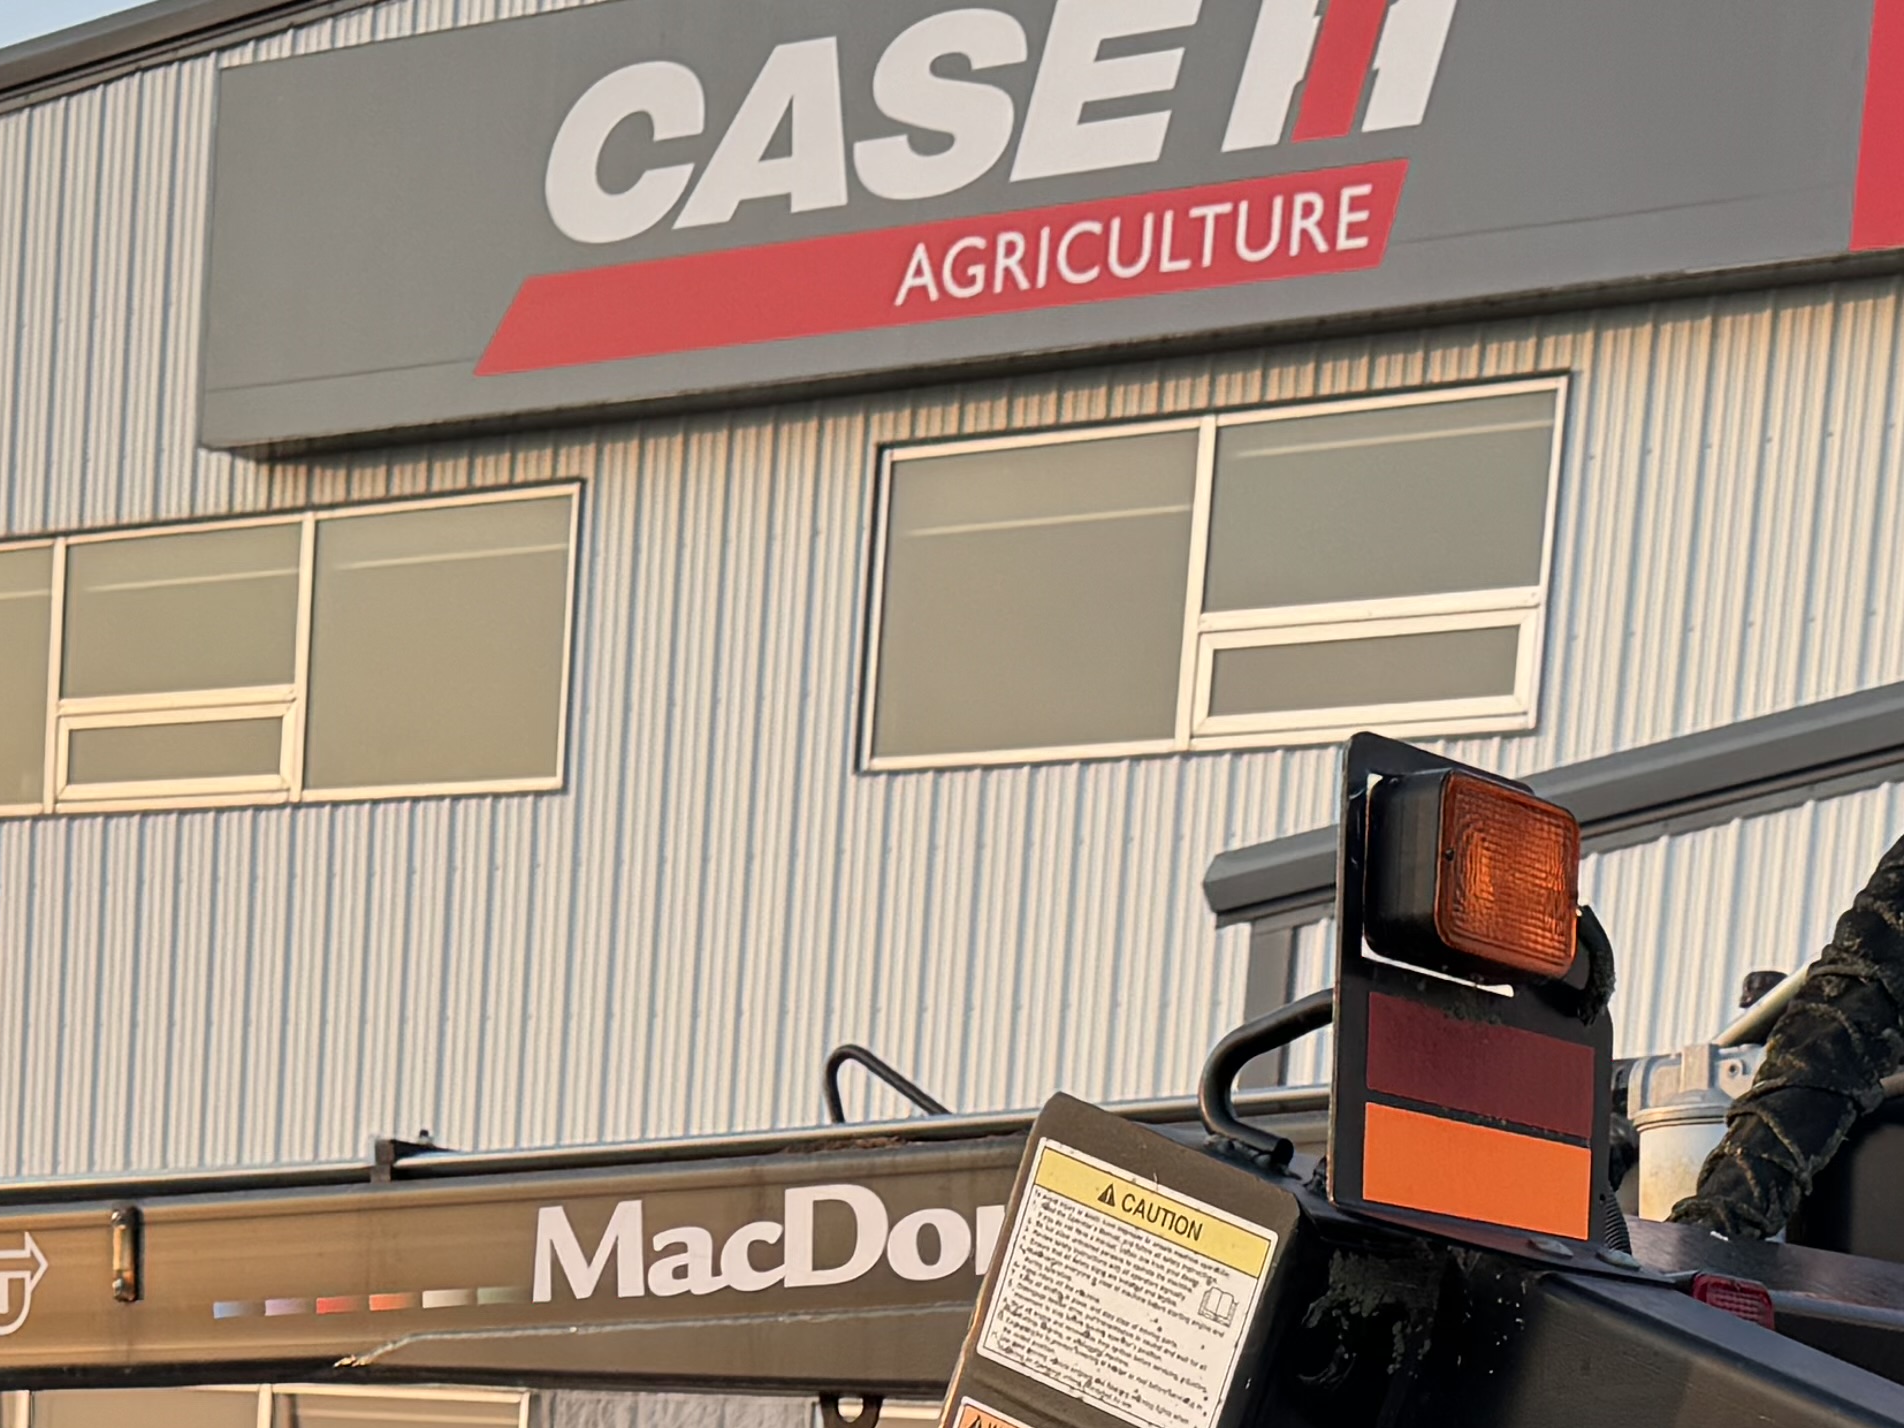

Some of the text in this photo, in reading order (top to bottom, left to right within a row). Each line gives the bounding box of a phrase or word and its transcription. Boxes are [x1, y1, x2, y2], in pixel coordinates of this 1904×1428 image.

[545, 0, 1197, 244] CASE
[894, 184, 1373, 307] AGRICULTURE
[1118, 1190, 1204, 1243] CAUTION
